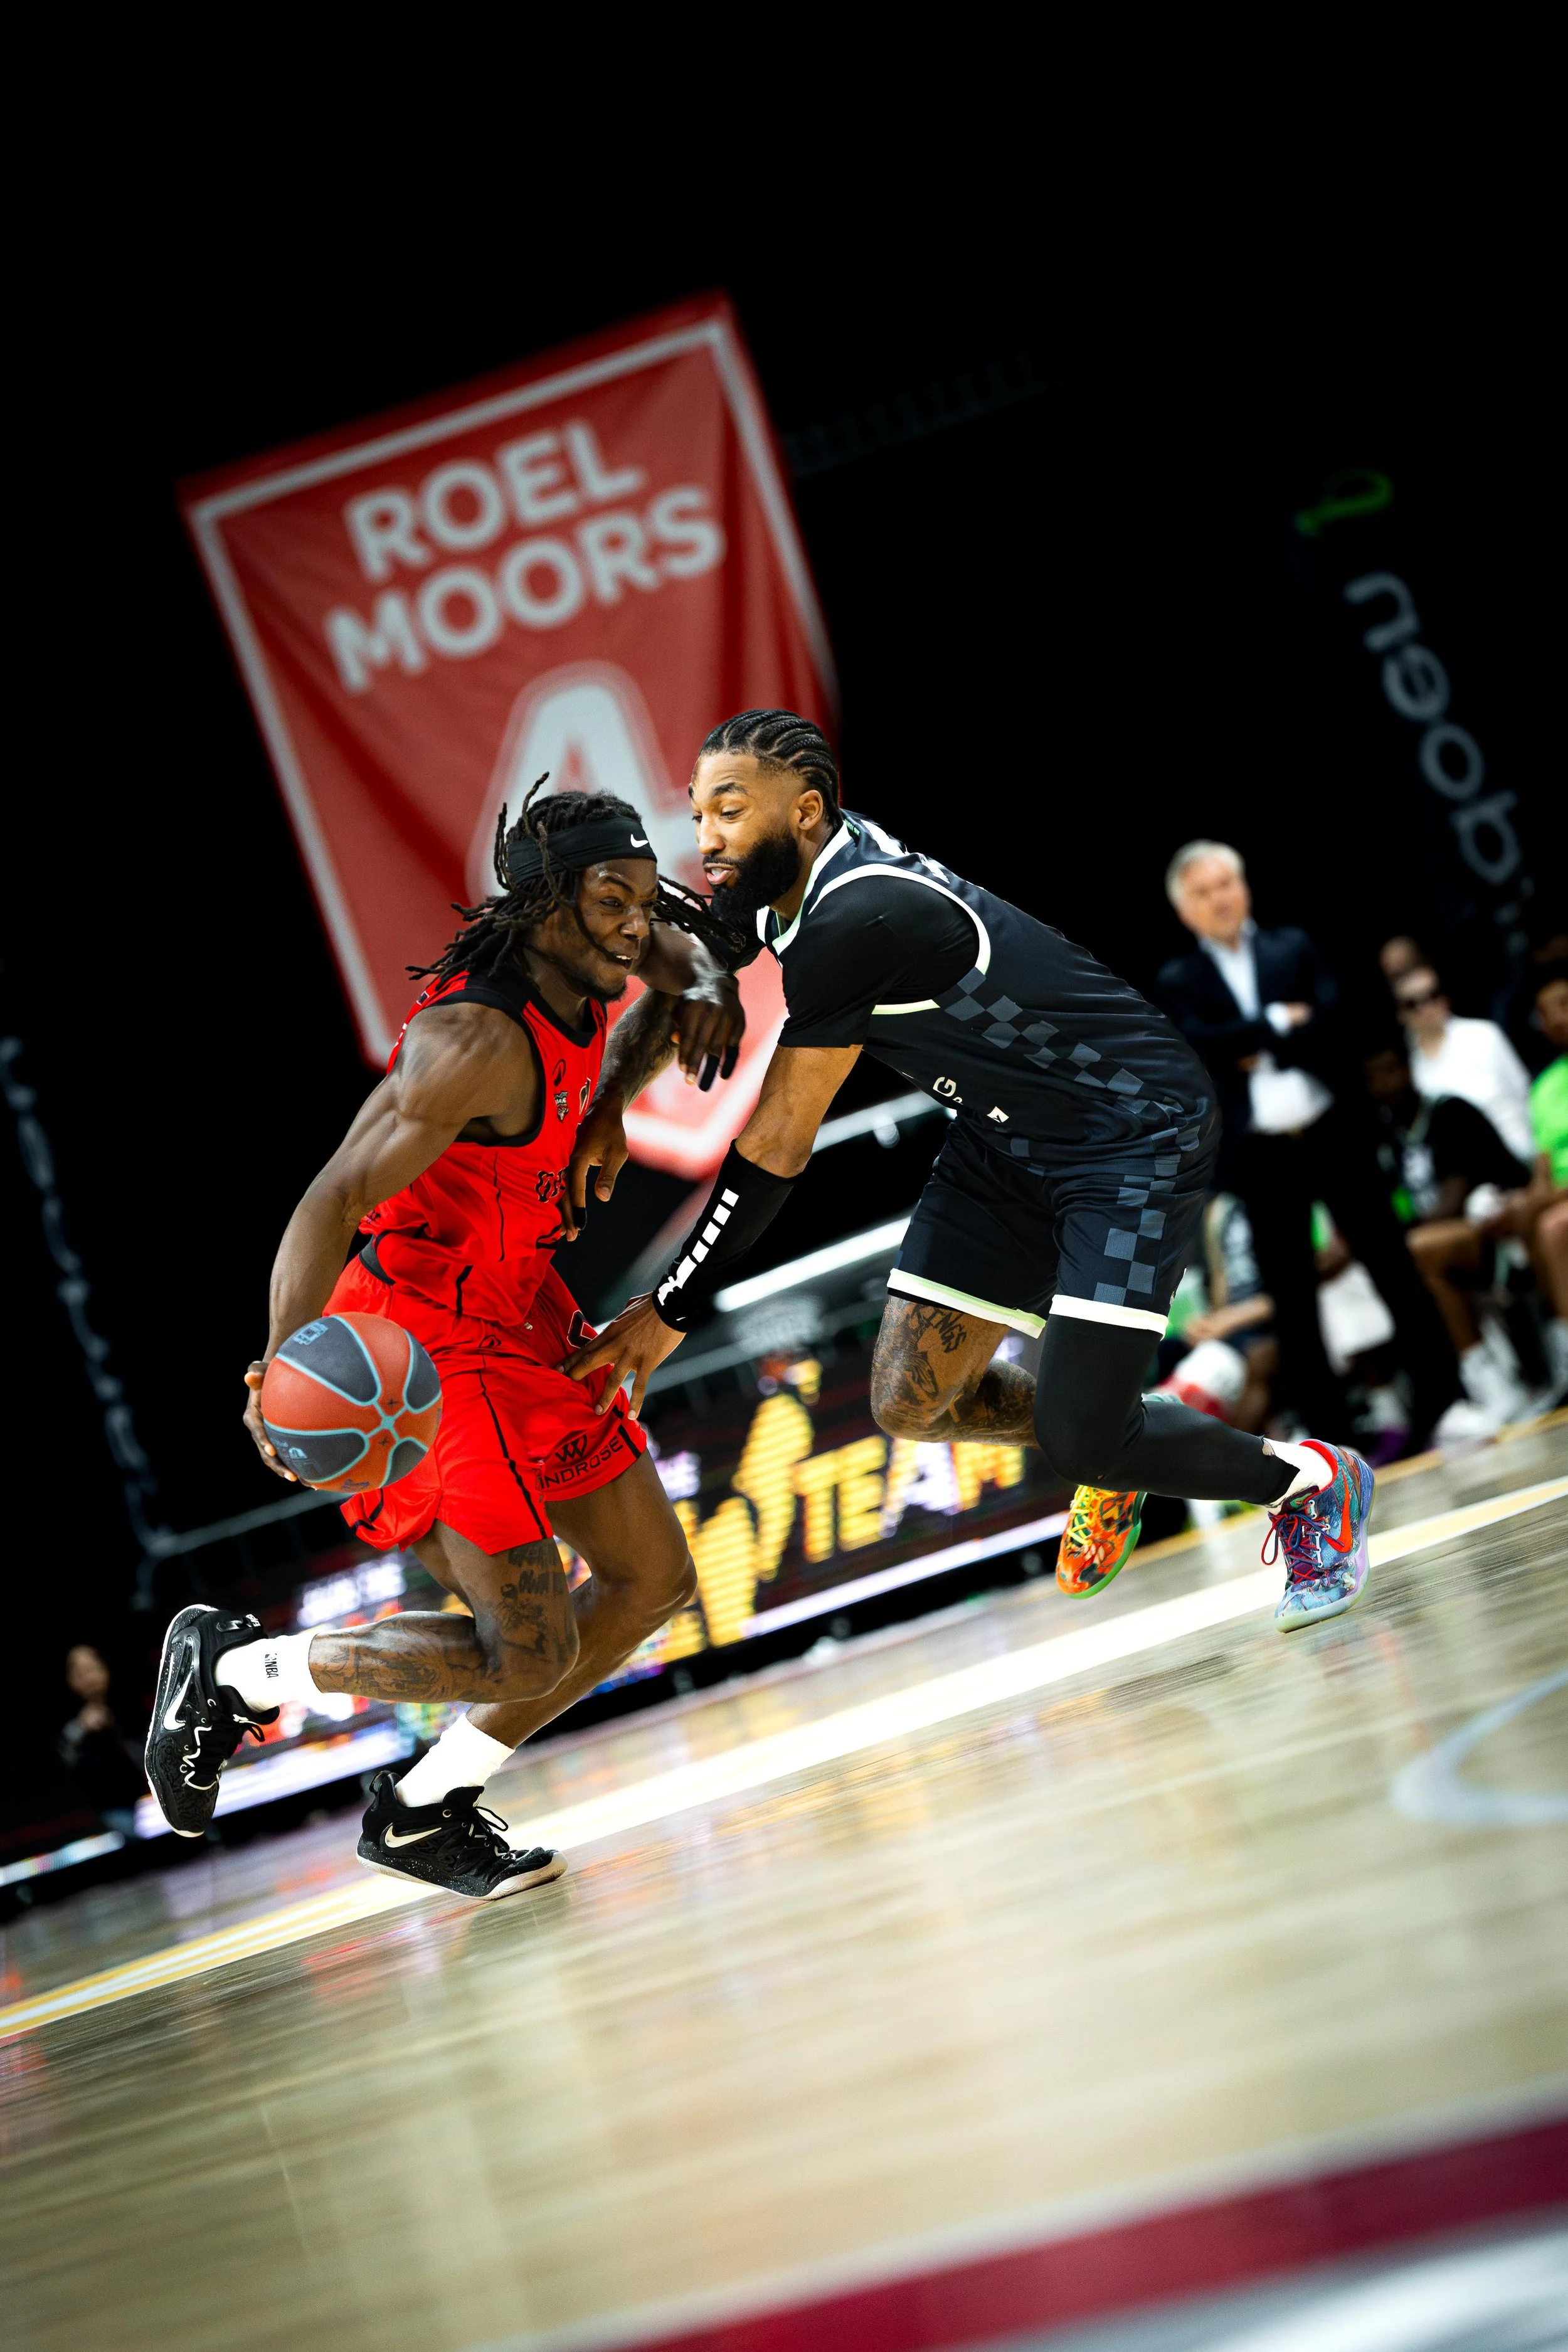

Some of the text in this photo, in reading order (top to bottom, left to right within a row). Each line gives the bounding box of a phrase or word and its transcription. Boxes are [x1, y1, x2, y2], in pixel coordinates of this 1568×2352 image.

[345, 420, 645, 581] ROEL
[325, 487, 726, 695] MOORS
[538, 1436, 623, 1489] INDROSE
[792, 1434, 1024, 1563] TEAM
[265, 1661, 278, 1678] NBA
